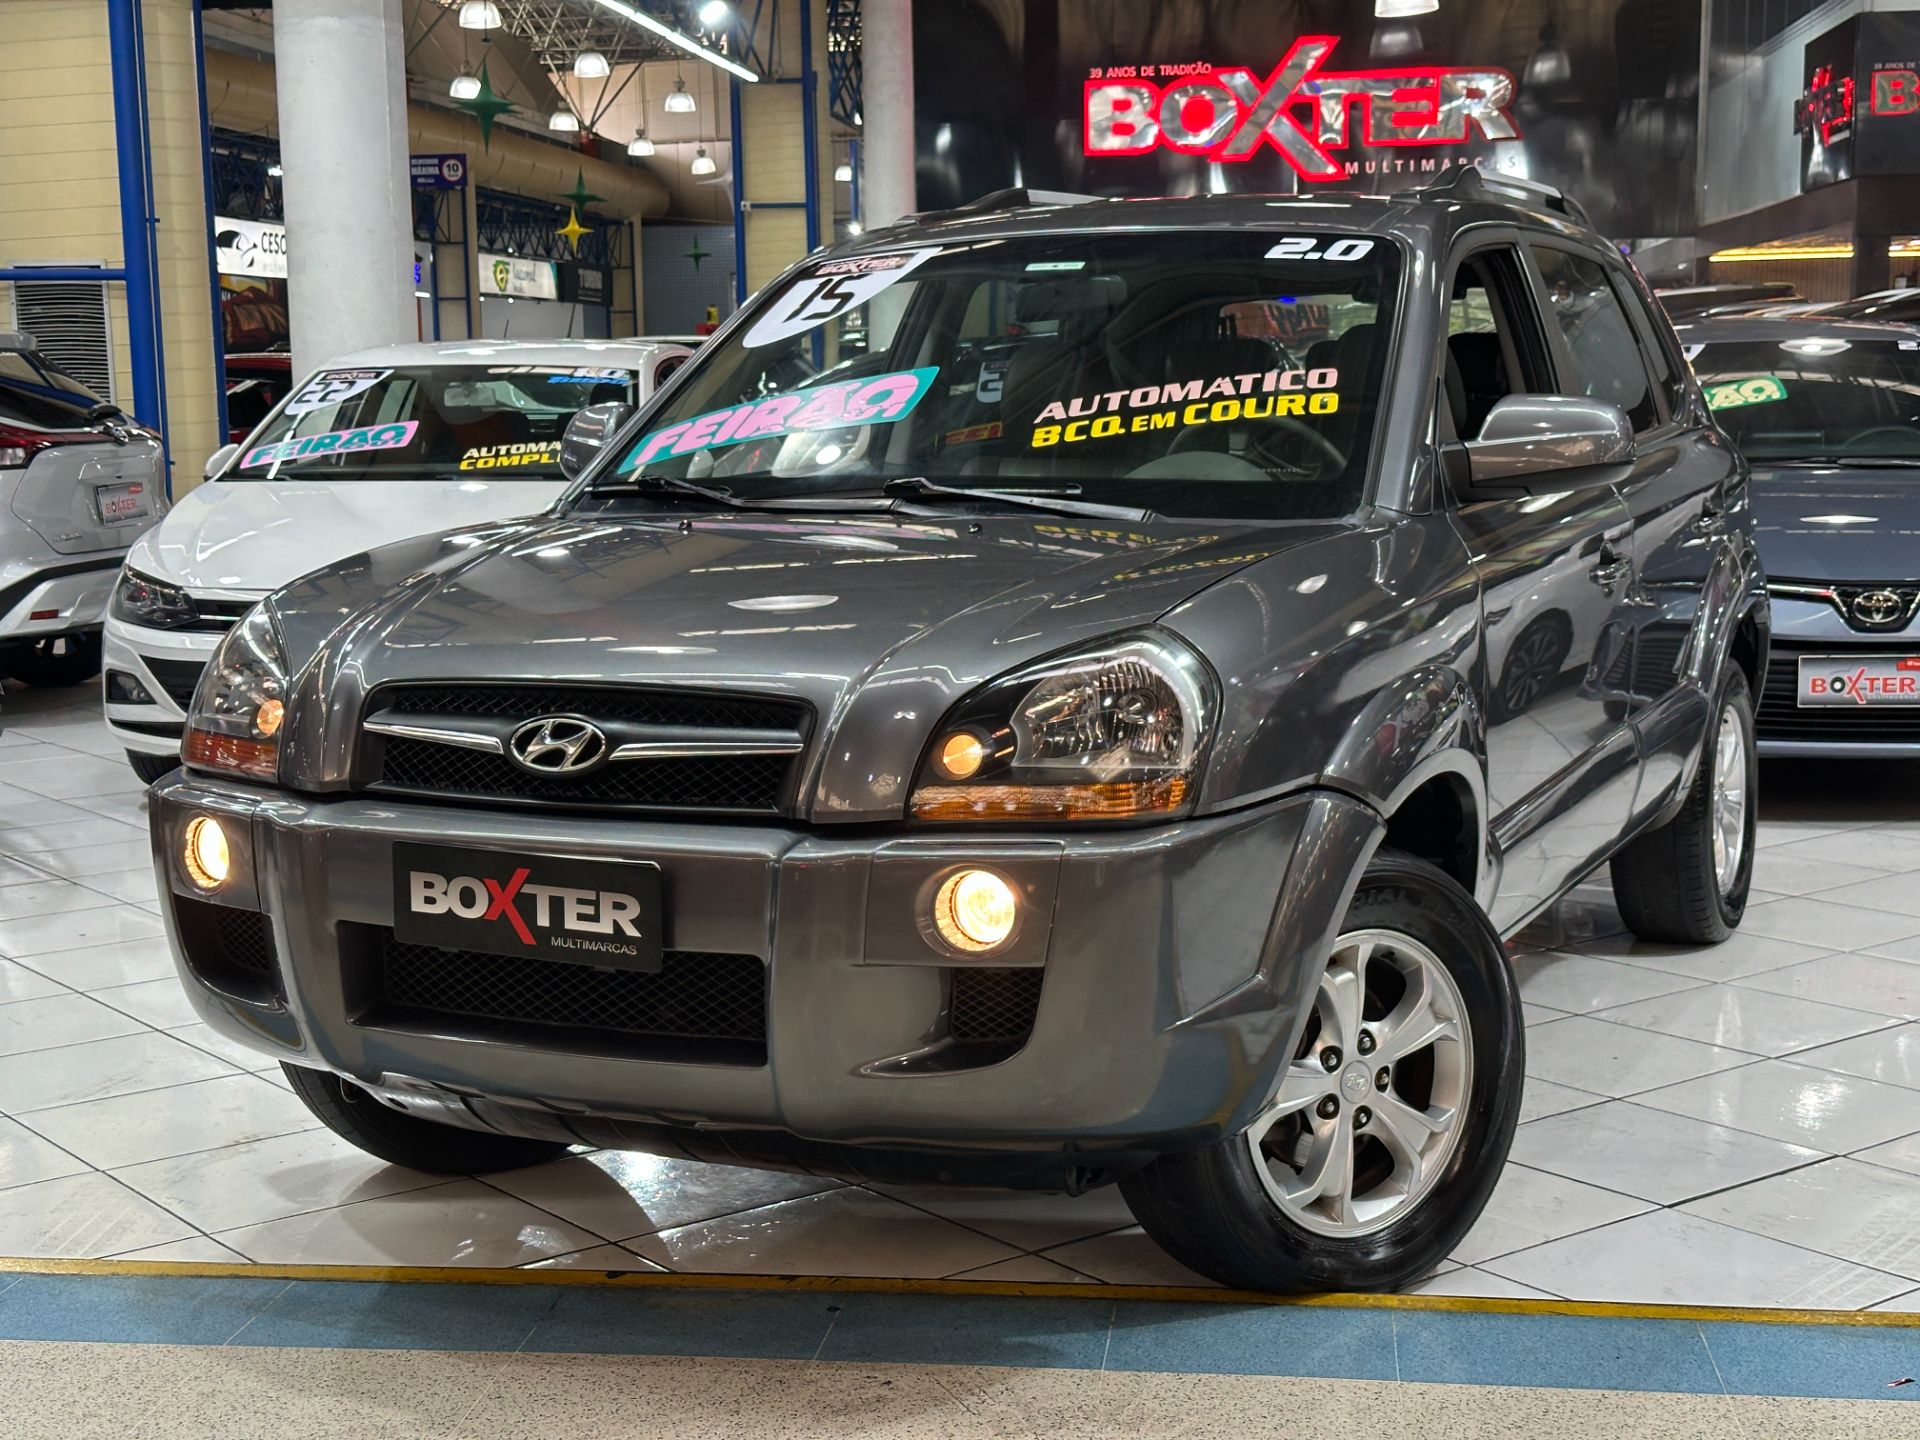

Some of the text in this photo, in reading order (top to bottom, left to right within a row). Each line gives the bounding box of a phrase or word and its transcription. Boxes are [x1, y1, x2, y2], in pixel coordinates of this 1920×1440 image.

[1089, 62, 1212, 79] 39 ANOS DE TRADIÇÃO
[1084, 35, 1524, 181] BOXTER
[1871, 70, 1920, 116] B
[445, 163, 460, 173] 10
[1263, 237, 1375, 262] 2.0
[814, 255, 902, 277] BOXTER
[782, 272, 874, 323] 15
[293, 380, 357, 403] 22
[1130, 410, 1177, 432] EM
[1182, 392, 1340, 426] COURO
[1808, 666, 1917, 704] BOXTER
[408, 867, 643, 946] BOXTER
[550, 935, 639, 956] MULTIMARCAS
